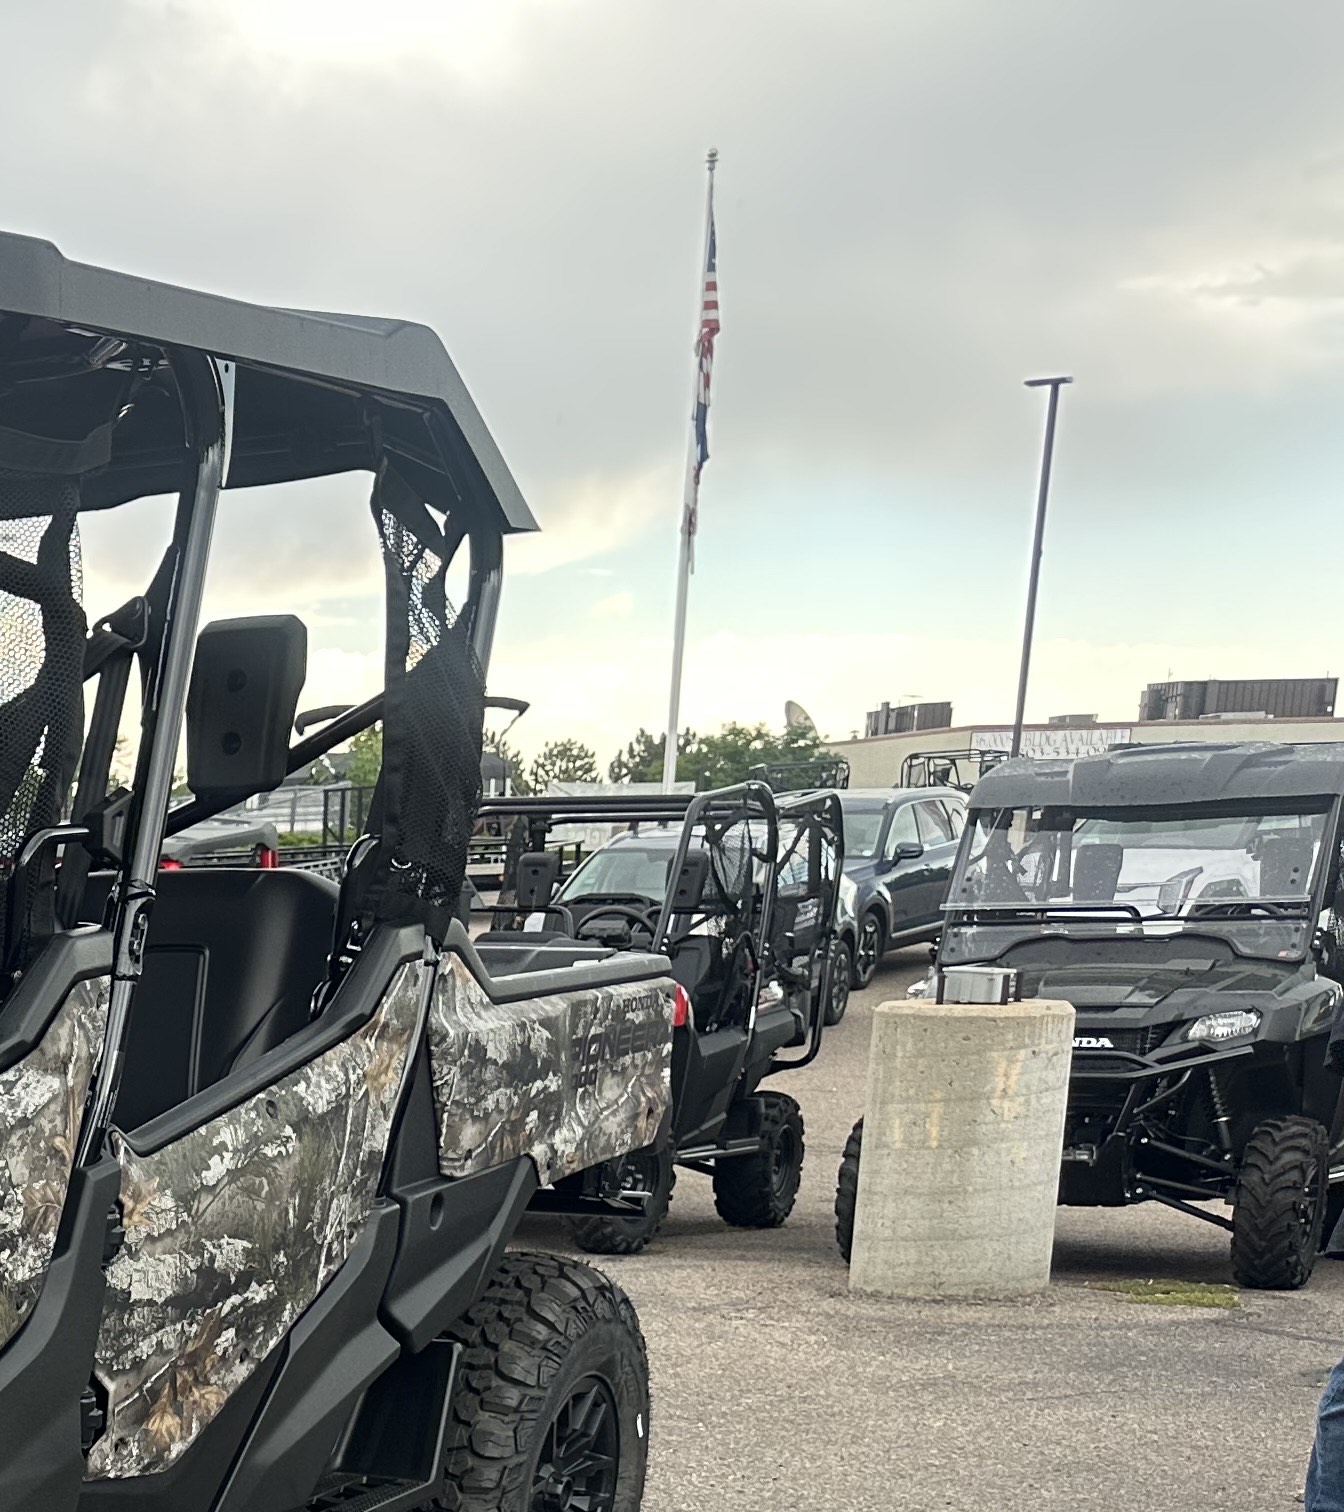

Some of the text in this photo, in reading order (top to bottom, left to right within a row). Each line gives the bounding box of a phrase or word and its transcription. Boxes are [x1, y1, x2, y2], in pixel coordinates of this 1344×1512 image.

[622, 993, 663, 1013] HONDA
[571, 1018, 670, 1064] PIONEER
[1072, 1037, 1114, 1048] NDA
